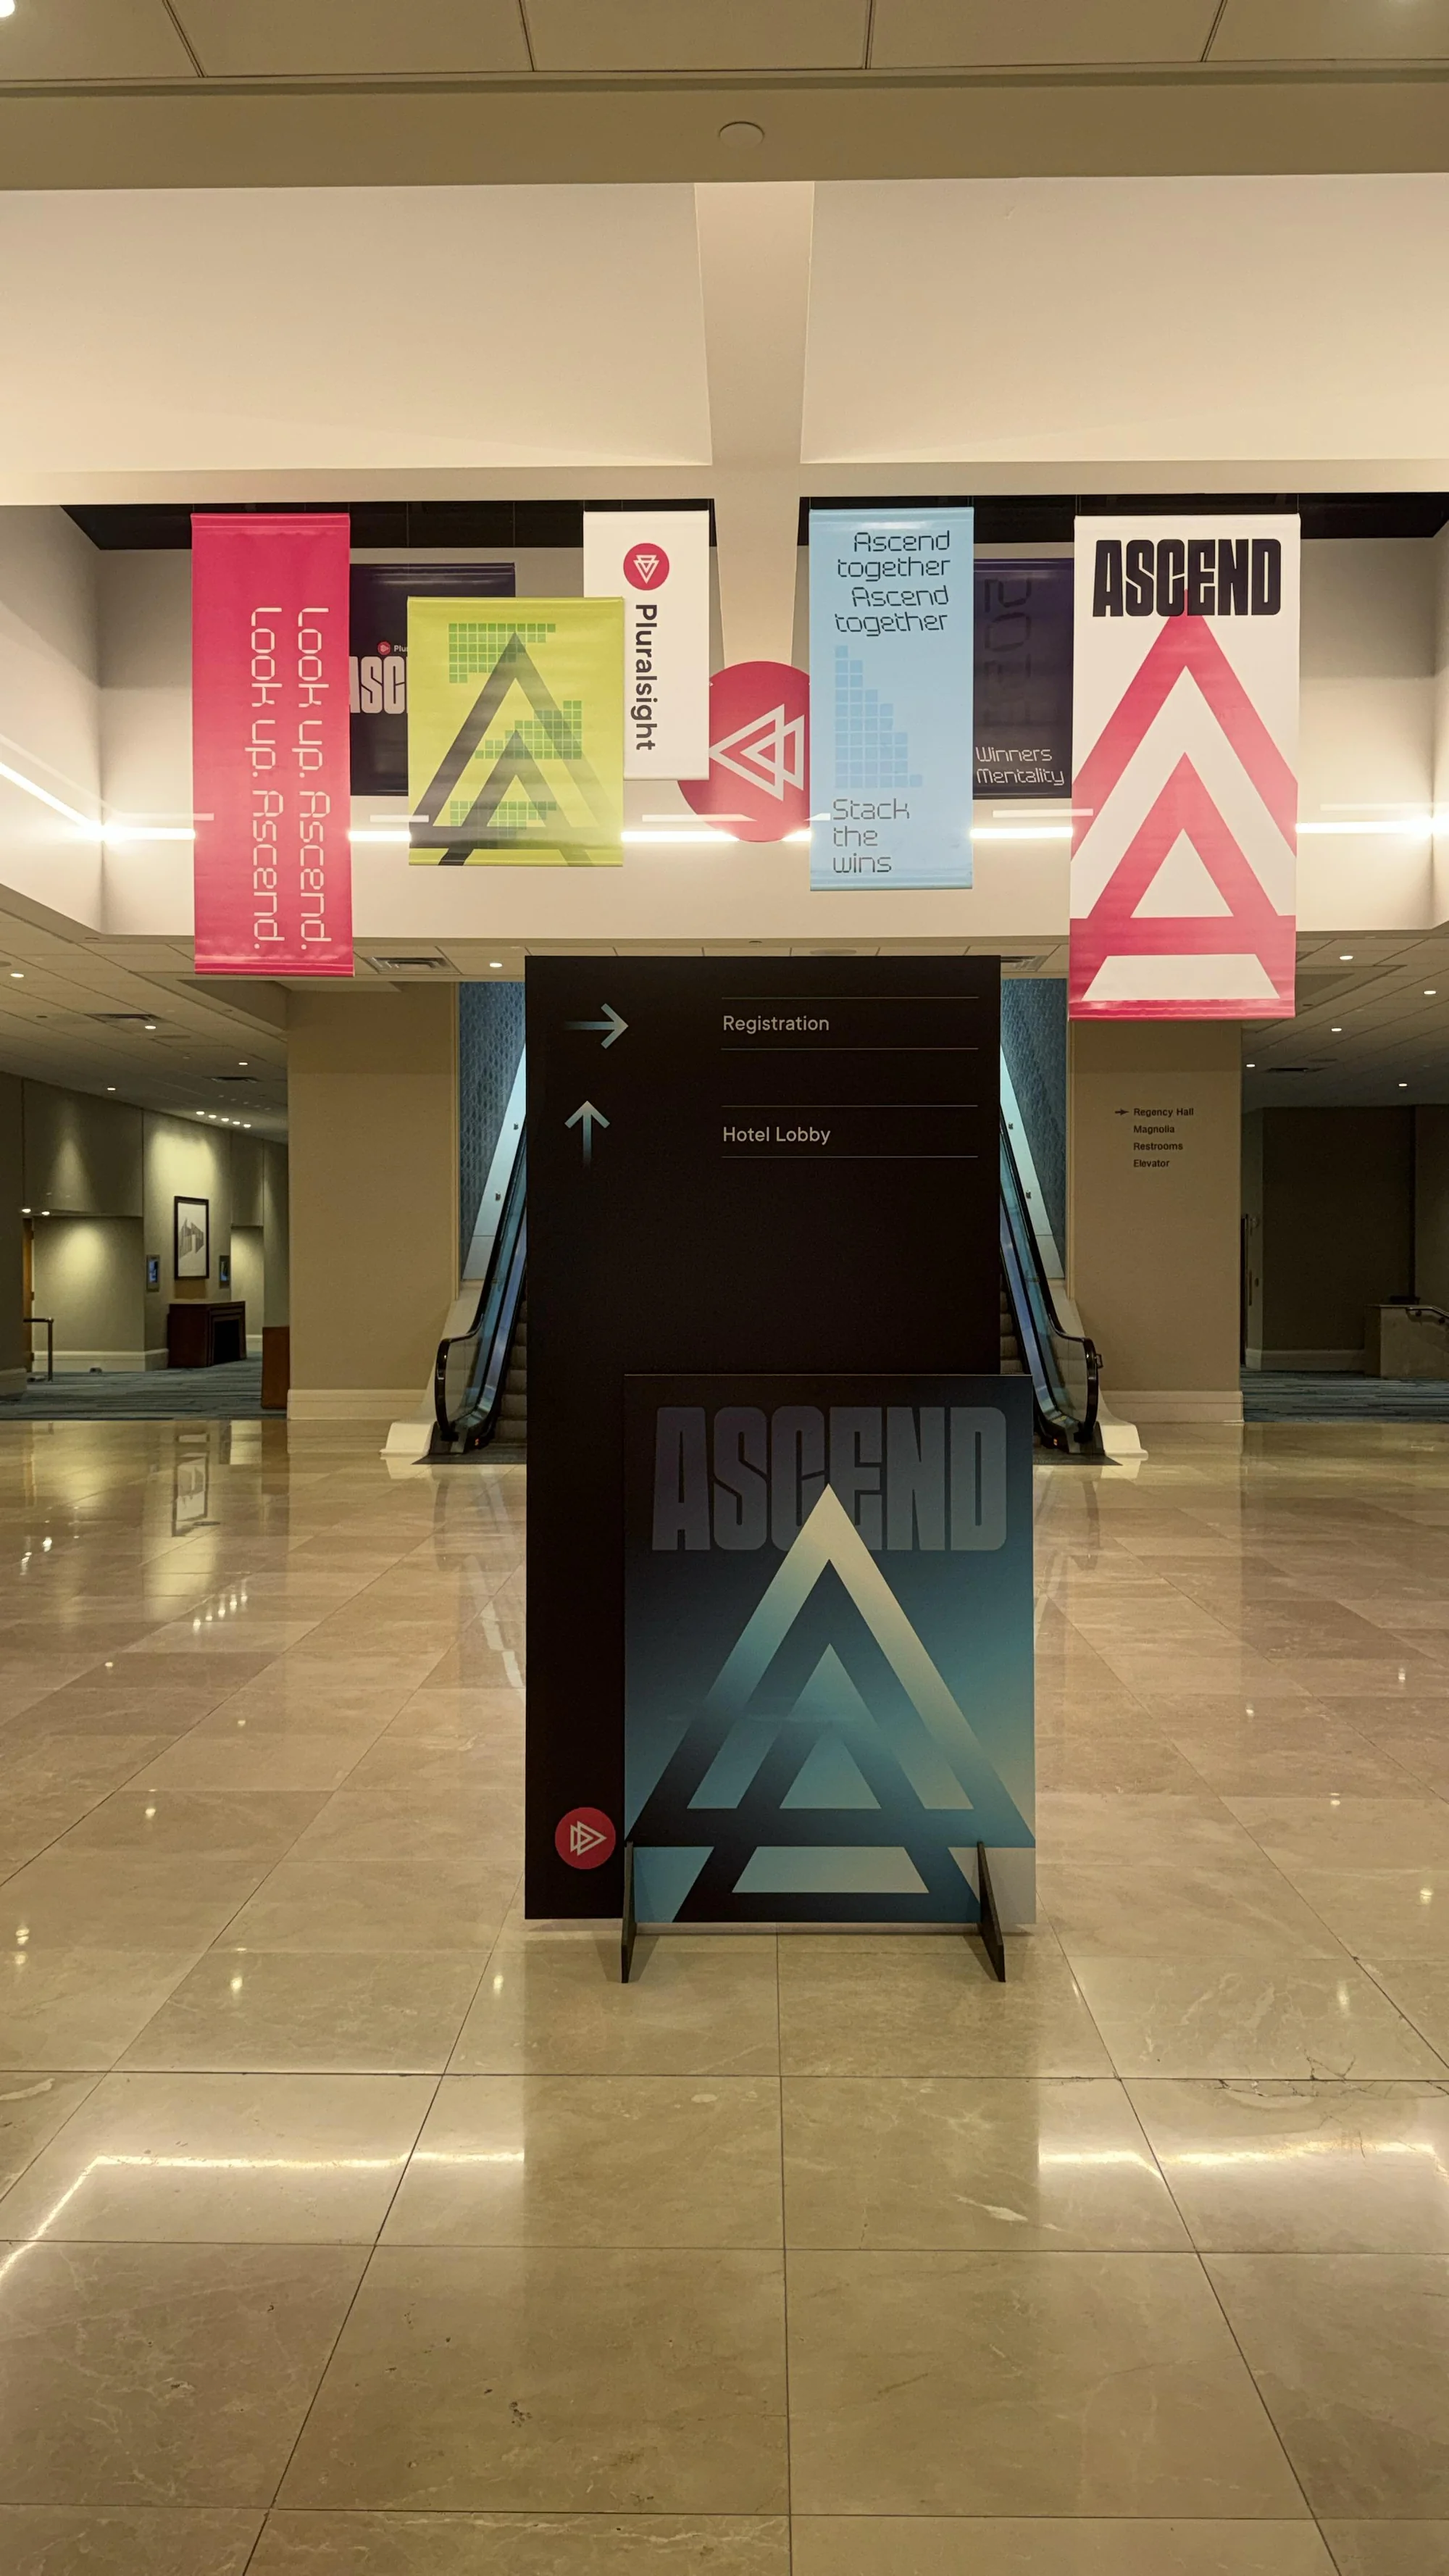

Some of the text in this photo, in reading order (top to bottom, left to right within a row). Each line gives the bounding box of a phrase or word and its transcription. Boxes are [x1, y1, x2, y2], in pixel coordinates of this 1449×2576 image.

[853, 530, 950, 552] Ascend
[838, 556, 951, 582] together
[1092, 538, 1282, 617] ASCEND
[851, 585, 949, 607] Ascend
[834, 611, 948, 637] together
[349, 656, 408, 714] SC
[630, 604, 658, 751] Pluralsight
[975, 746, 1053, 762] Winners
[244, 607, 285, 949] Look up. Ascend.
[291, 607, 333, 950] Look up. Ascend.
[976, 767, 1065, 785] Mentality
[833, 798, 910, 820] Stack
[833, 825, 878, 847] the
[833, 852, 892, 873] wins
[723, 1015, 830, 1034] Registration
[1133, 1107, 1194, 1118] Regency Hall
[723, 1126, 831, 1146] Hotel Lobby
[1133, 1125, 1175, 1135] Magnolia
[1133, 1142, 1184, 1151] Restrooms
[1133, 1159, 1170, 1168] Elevator
[651, 1405, 1008, 1551] ASCEND
